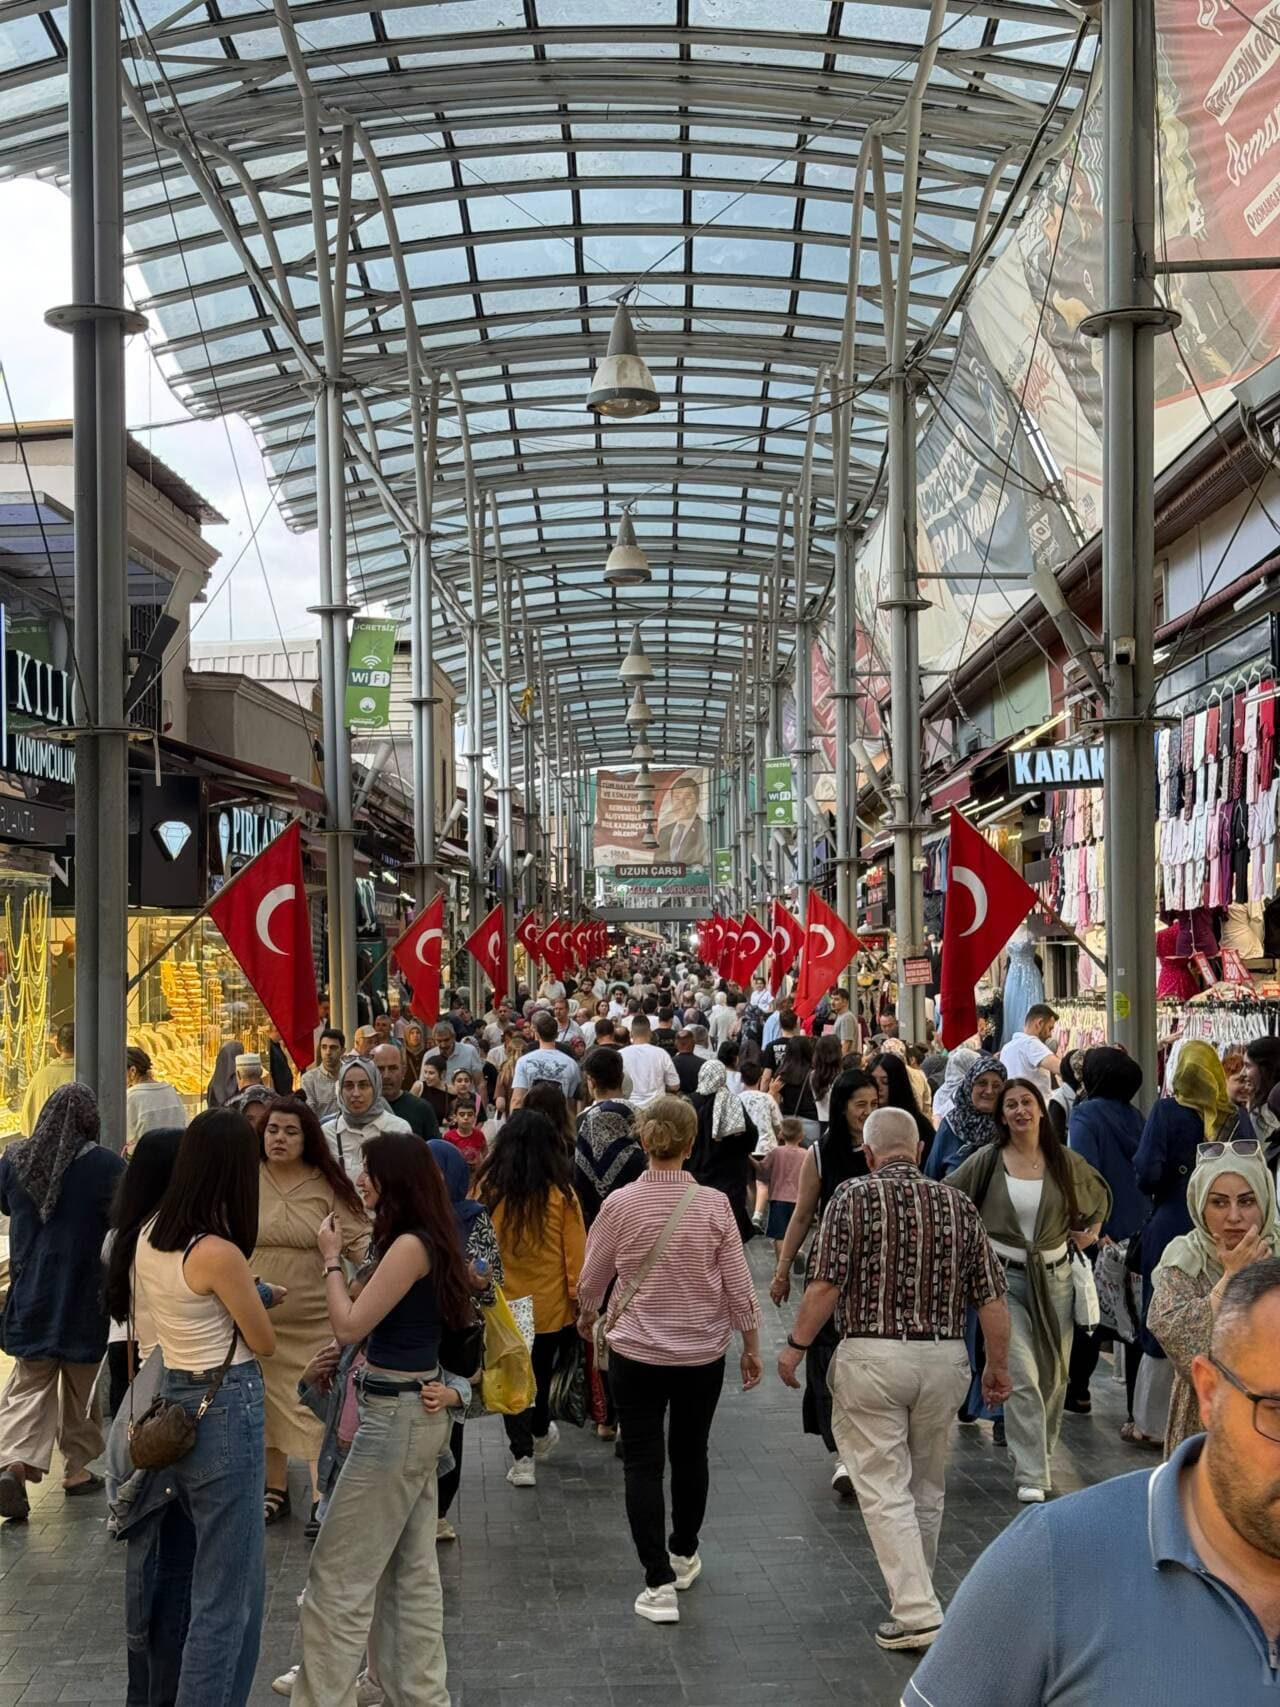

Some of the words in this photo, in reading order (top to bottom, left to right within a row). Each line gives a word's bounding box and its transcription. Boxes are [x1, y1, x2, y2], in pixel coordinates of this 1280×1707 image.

[16, 649, 77, 726] KILI
[15, 733, 76, 785] KUYUMCULUK
[620, 866, 648, 876] UZUN
[651, 866, 682, 877] ÇARŞI
